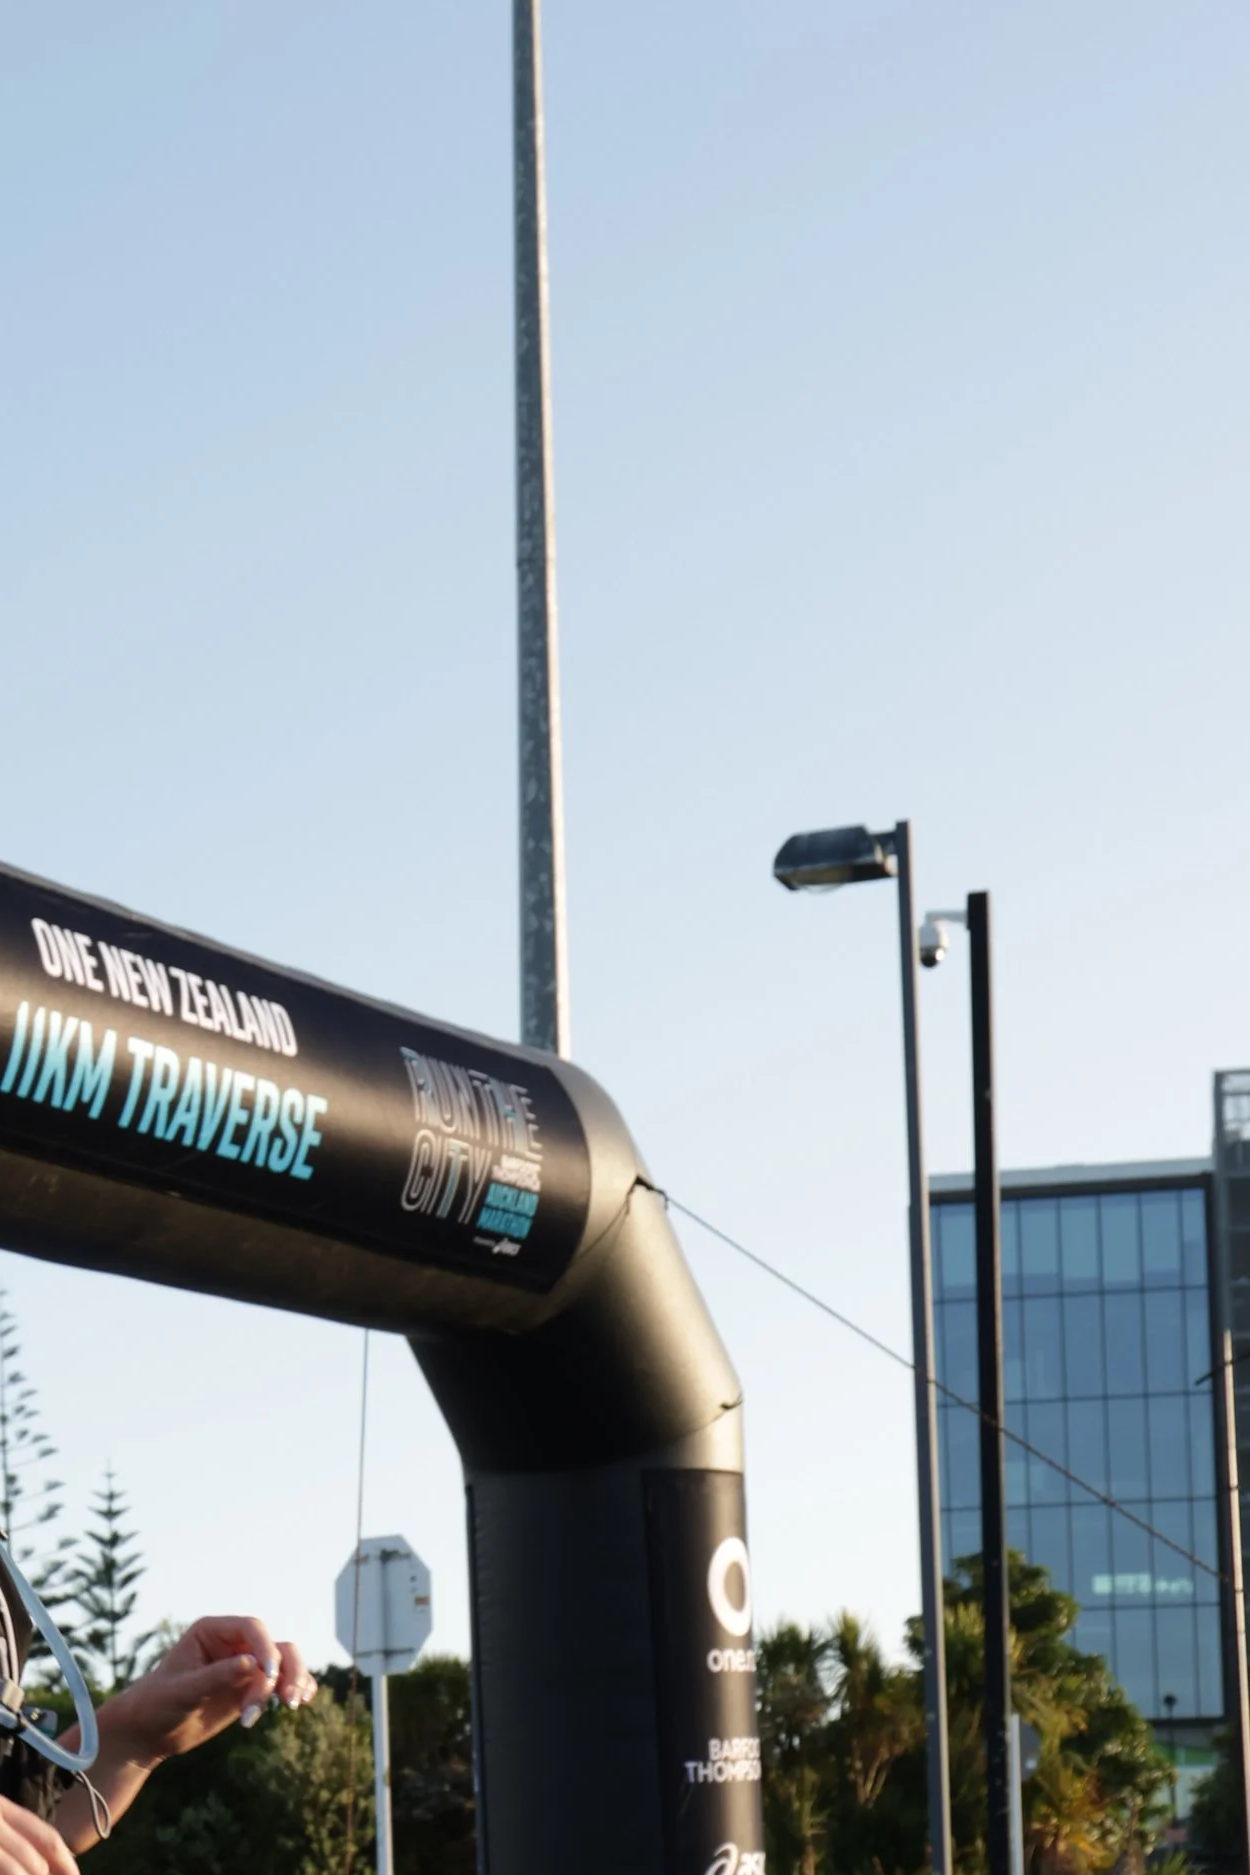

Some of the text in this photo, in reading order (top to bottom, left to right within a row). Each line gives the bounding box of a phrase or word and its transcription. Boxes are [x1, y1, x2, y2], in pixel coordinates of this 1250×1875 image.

[31, 918, 298, 1058] ONE NEW ZEALAND
[117, 1036, 328, 1181] TRAVERSE
[401, 1128, 492, 1225] CITY
